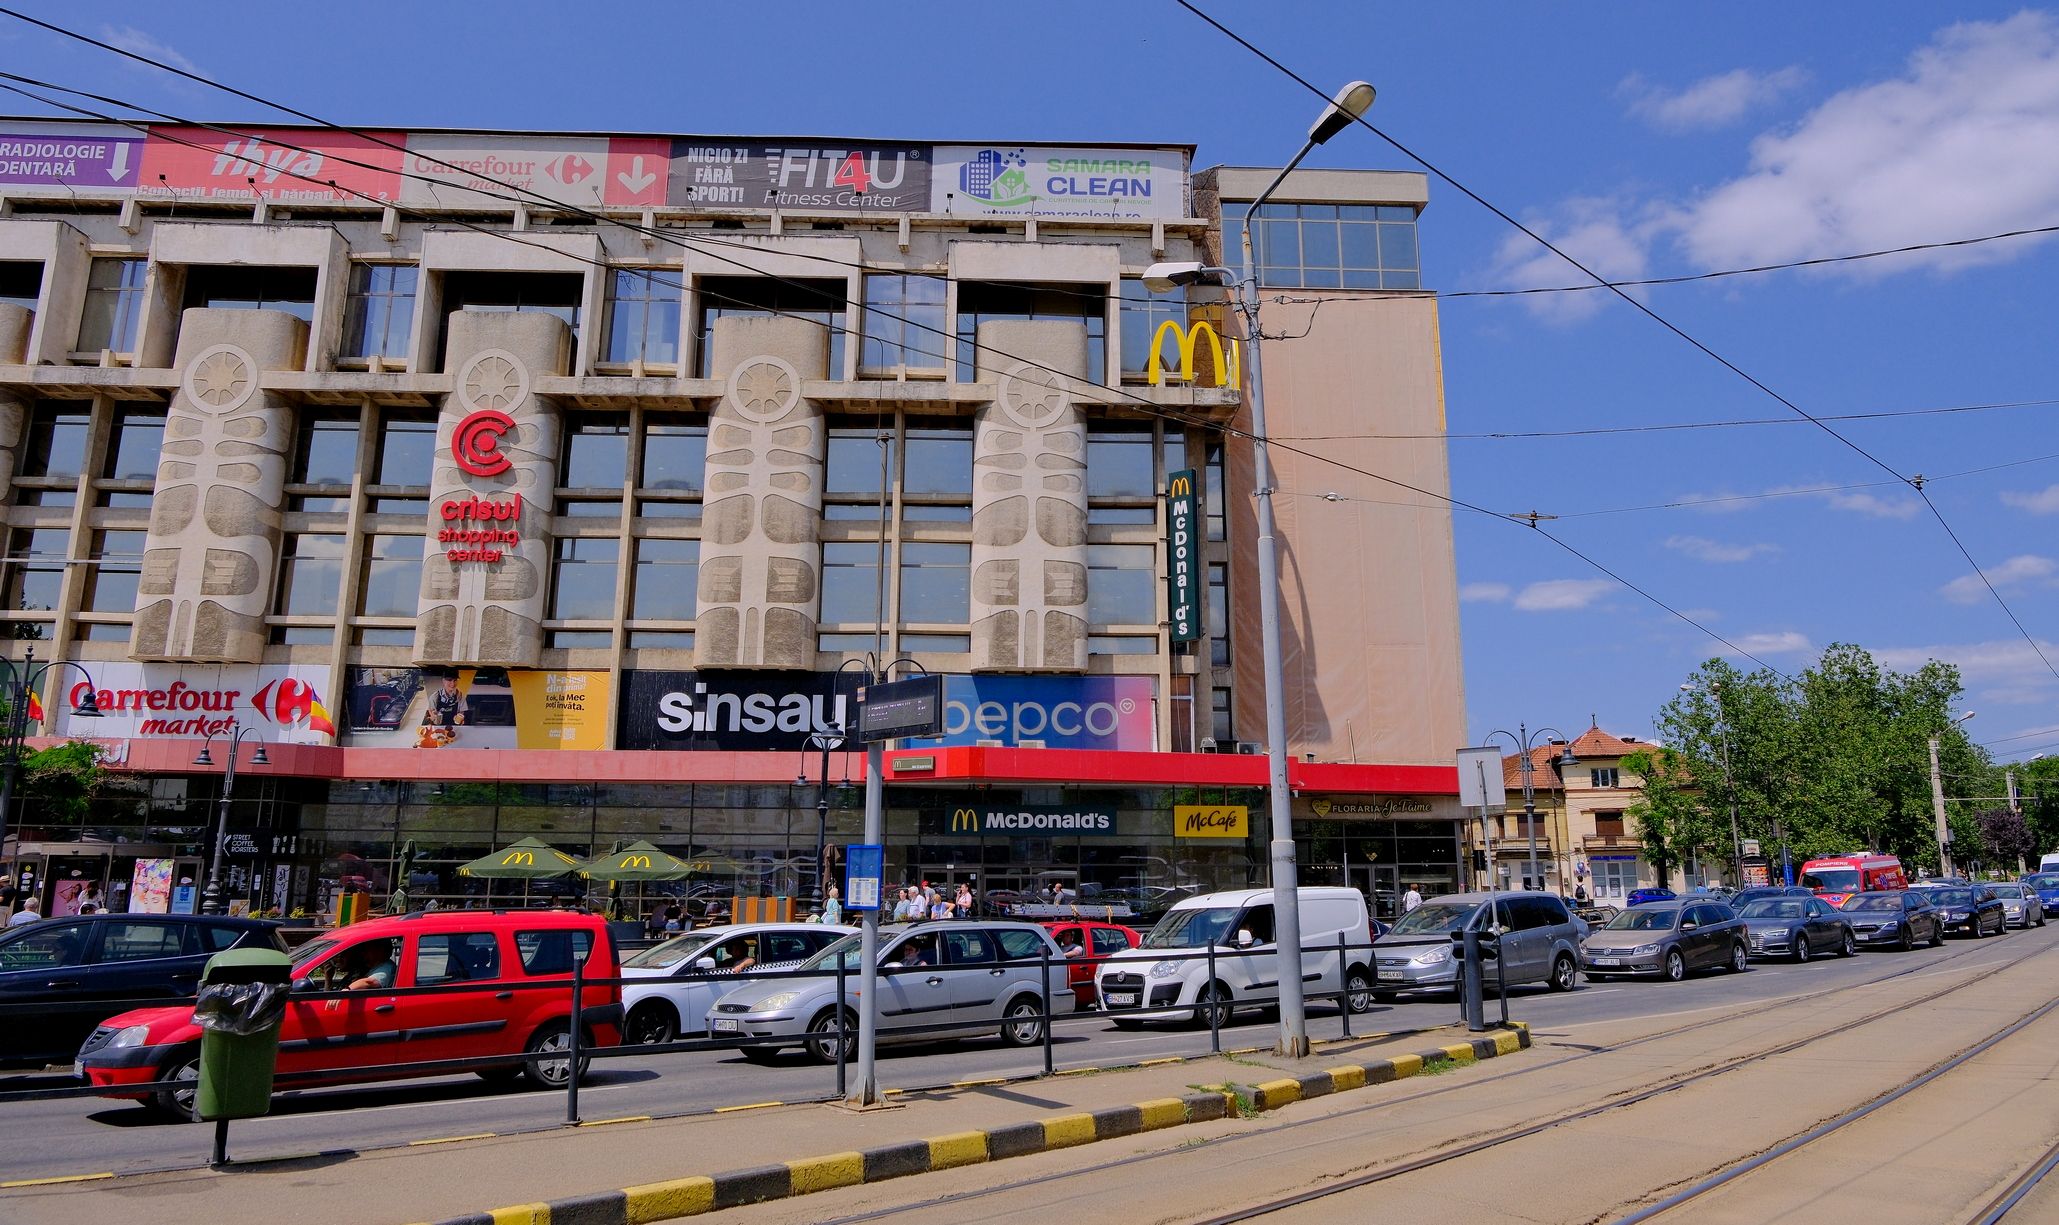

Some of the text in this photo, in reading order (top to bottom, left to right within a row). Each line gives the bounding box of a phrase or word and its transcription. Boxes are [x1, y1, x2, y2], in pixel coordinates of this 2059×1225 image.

[0, 142, 106, 159] RADIOLOGIE
[210, 134, 324, 184] thya
[687, 147, 749, 164] NICIO ZI
[0, 160, 76, 176] DENTARĂ
[414, 154, 536, 176] Carrefour
[694, 165, 734, 184] FĂRĂ
[776, 148, 906, 192] FIT4U
[1046, 158, 1152, 174] SAMARA
[467, 177, 536, 192] market
[1046, 176, 1152, 197] CLEAN
[687, 186, 745, 203] SPORT!
[763, 189, 901, 207] Fitness Center
[440, 492, 522, 521] crisul
[438, 528, 519, 548] shopping
[447, 545, 503, 562] center
[1173, 500, 1190, 636] McDonald's
[69, 680, 241, 712] Carrefour
[566, 694, 586, 702] Mec
[140, 714, 236, 737] market
[985, 812, 1110, 829] McDonald's
[1185, 809, 1238, 832] McCafé
